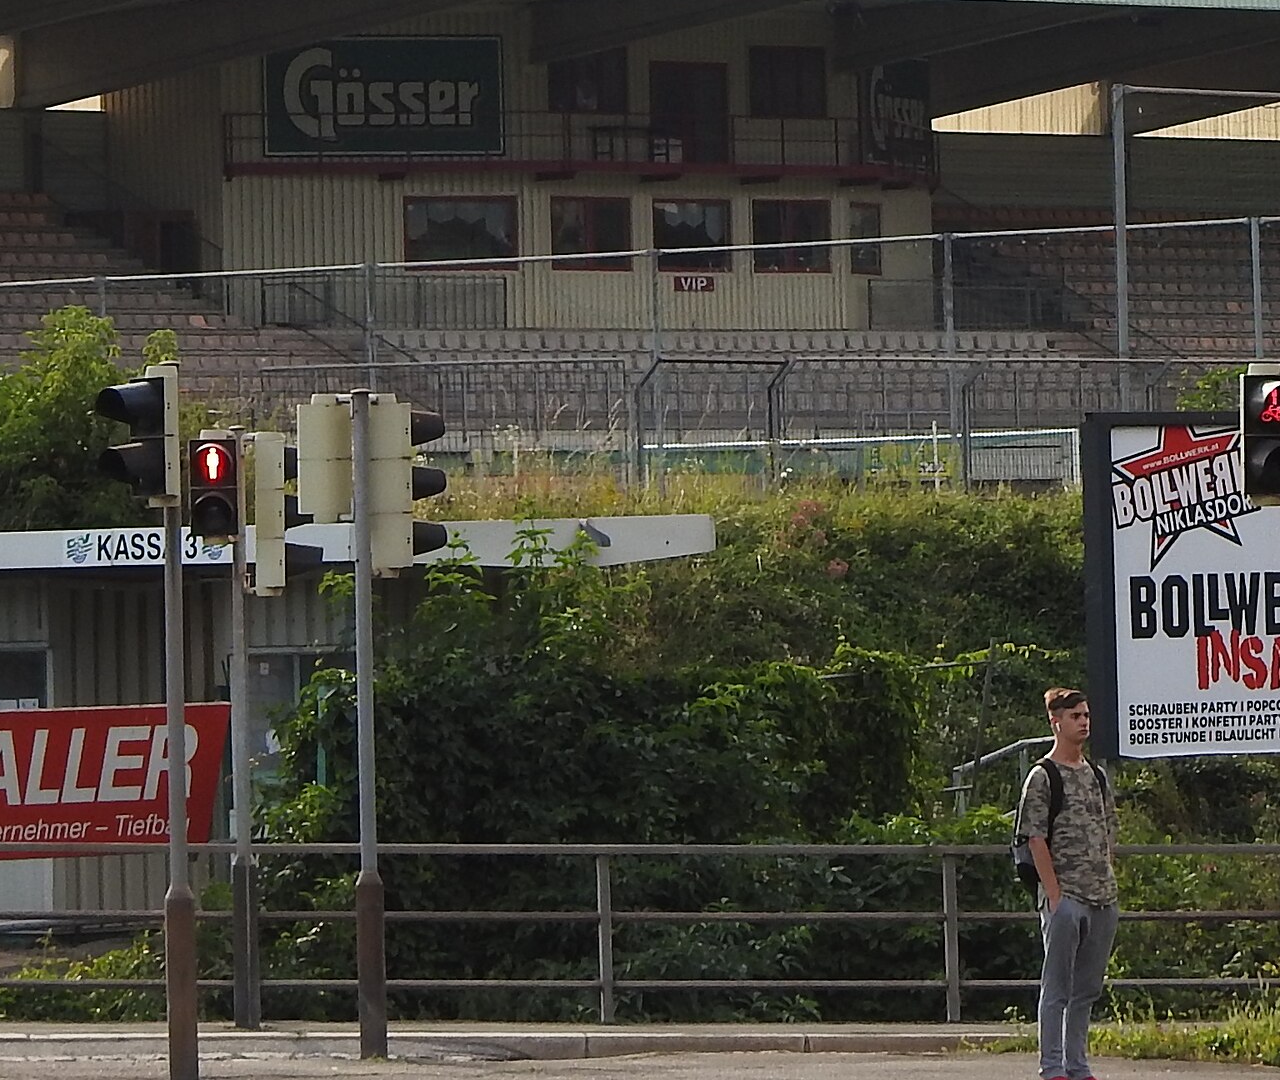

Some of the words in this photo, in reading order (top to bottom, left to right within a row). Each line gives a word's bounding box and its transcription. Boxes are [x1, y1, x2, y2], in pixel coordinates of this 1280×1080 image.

[283, 47, 480, 142] Gösser
[681, 277, 708, 291] VIP
[1156, 494, 1257, 535] NIKLASDOR
[97, 532, 167, 561] KASS
[184, 533, 198, 559] 3
[1129, 701, 1199, 717] SCHRAUBEN
[1201, 700, 1238, 714] PARTY
[1129, 716, 1183, 731] BOOSTER
[1192, 714, 1247, 729] KONFETTI
[1129, 730, 1159, 745] 90ER
[1161, 729, 1207, 744] STUNDE
[1215, 727, 1276, 742] BLAULICHT
[115, 814, 190, 837] Tiefb
